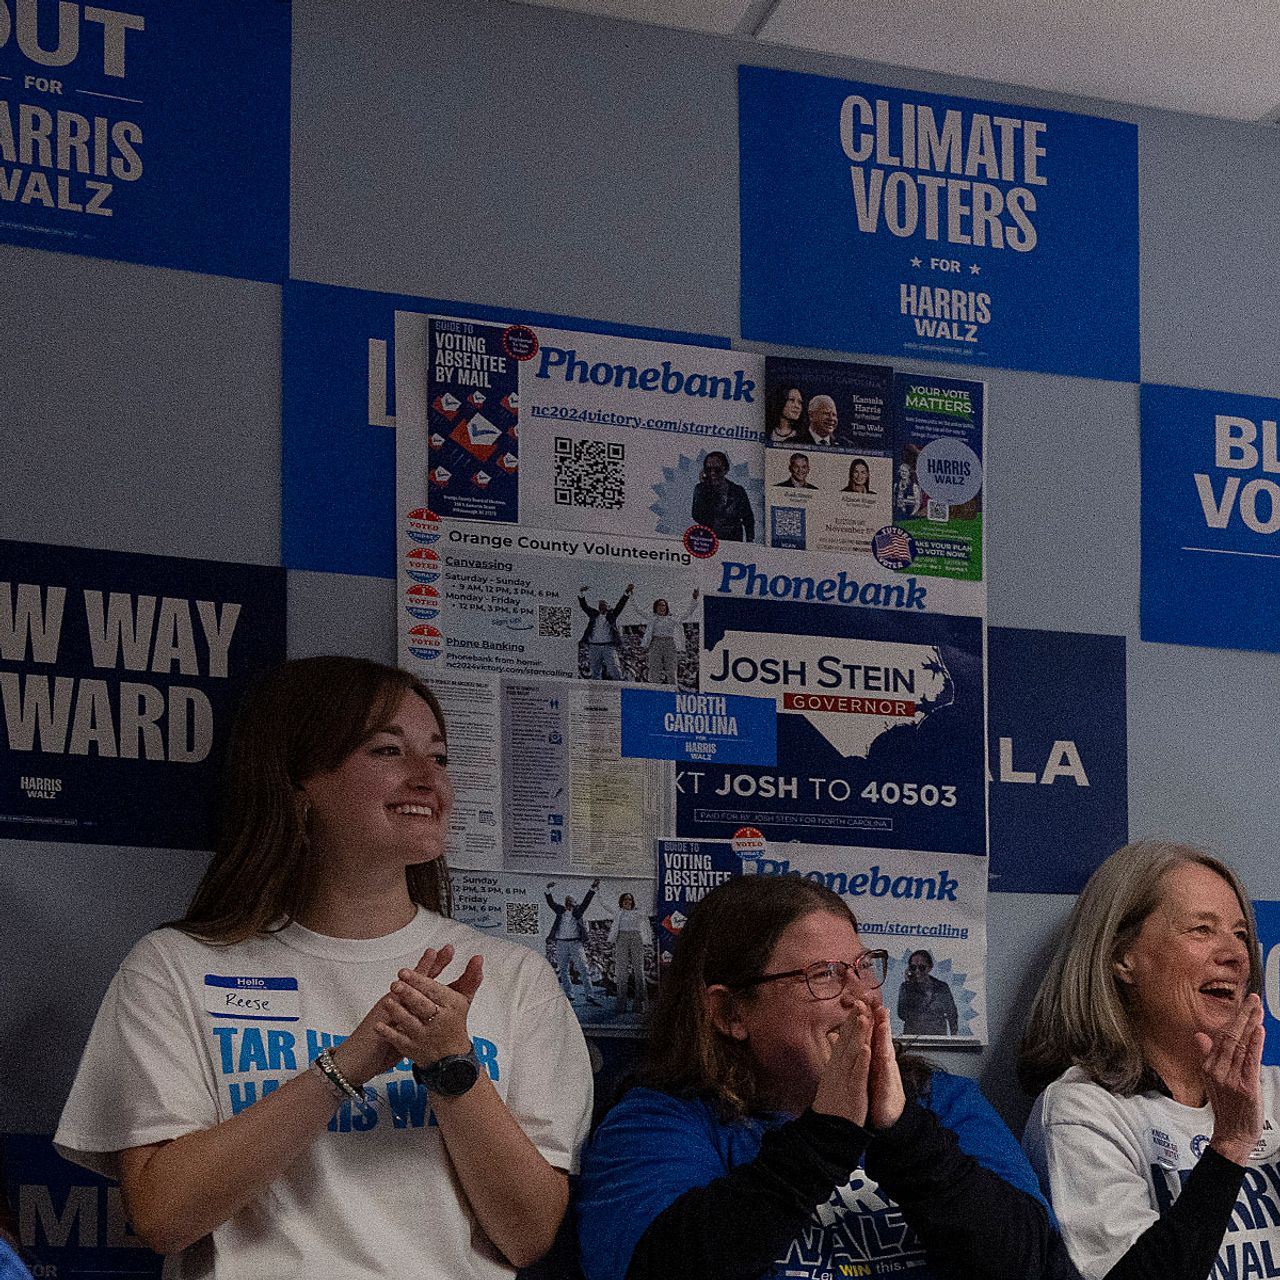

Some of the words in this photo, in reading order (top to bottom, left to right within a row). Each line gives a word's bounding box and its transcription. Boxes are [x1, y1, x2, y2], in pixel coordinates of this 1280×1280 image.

[0, 0, 145, 78] UT
[24, 75, 63, 95] FOR
[839, 95, 1047, 186] CLIMATE
[850, 166, 1037, 252] VOTERS
[930, 258, 960, 273] FOR
[900, 283, 991, 324] HARRIS
[914, 319, 978, 343] WALZ
[435, 332, 486, 353] VOTING
[435, 351, 507, 373] ABSENTEE
[435, 367, 453, 384] BY
[457, 368, 492, 388] MAIL
[535, 347, 756, 403] Phonebank
[910, 385, 941, 397] YOUR
[943, 388, 970, 399] VOTE
[905, 396, 976, 414] MATTERS.
[927, 458, 971, 476] HARRIS
[934, 474, 965, 486] WALZ
[409, 521, 440, 531] VOTED
[449, 529, 513, 549] Orange
[518, 536, 579, 556] County
[583, 540, 692, 566] Volunteering
[409, 560, 439, 570] VOTED
[445, 556, 513, 572] Canvassing
[445, 572, 487, 584] Saturday
[496, 576, 531, 587] Sunday
[718, 561, 927, 610] Phonebank
[409, 597, 439, 607] VOTED
[445, 592, 484, 603] Monday
[491, 596, 521, 607] Friday
[84, 590, 242, 678] WAY
[411, 638, 441, 647] VOTED
[445, 637, 480, 648] Phone
[482, 639, 525, 653] Banking
[709, 648, 806, 687] JOSH
[817, 655, 916, 695] STEIN
[675, 694, 727, 716] NORTH
[792, 695, 907, 715] GOVERNOR
[664, 712, 738, 736] CAROLINA
[685, 741, 717, 753] HARRIS
[690, 752, 712, 761] WALZ
[990, 736, 1090, 787] LA
[20, 776, 62, 793] HARRIS
[715, 773, 798, 799] JOSH
[809, 778, 851, 801] TO
[860, 780, 957, 808] 40503
[27, 790, 56, 799] WALZ
[663, 853, 712, 870] VOTING
[462, 875, 498, 885] Sunday
[458, 894, 488, 904] Friday
[665, 886, 681, 902] BY
[236, 977, 265, 987] Hello
[224, 993, 271, 1011] Reese
[212, 1027, 298, 1075] TAR
[839, 1264, 871, 1277] WIN
[876, 1261, 906, 1274] this.
